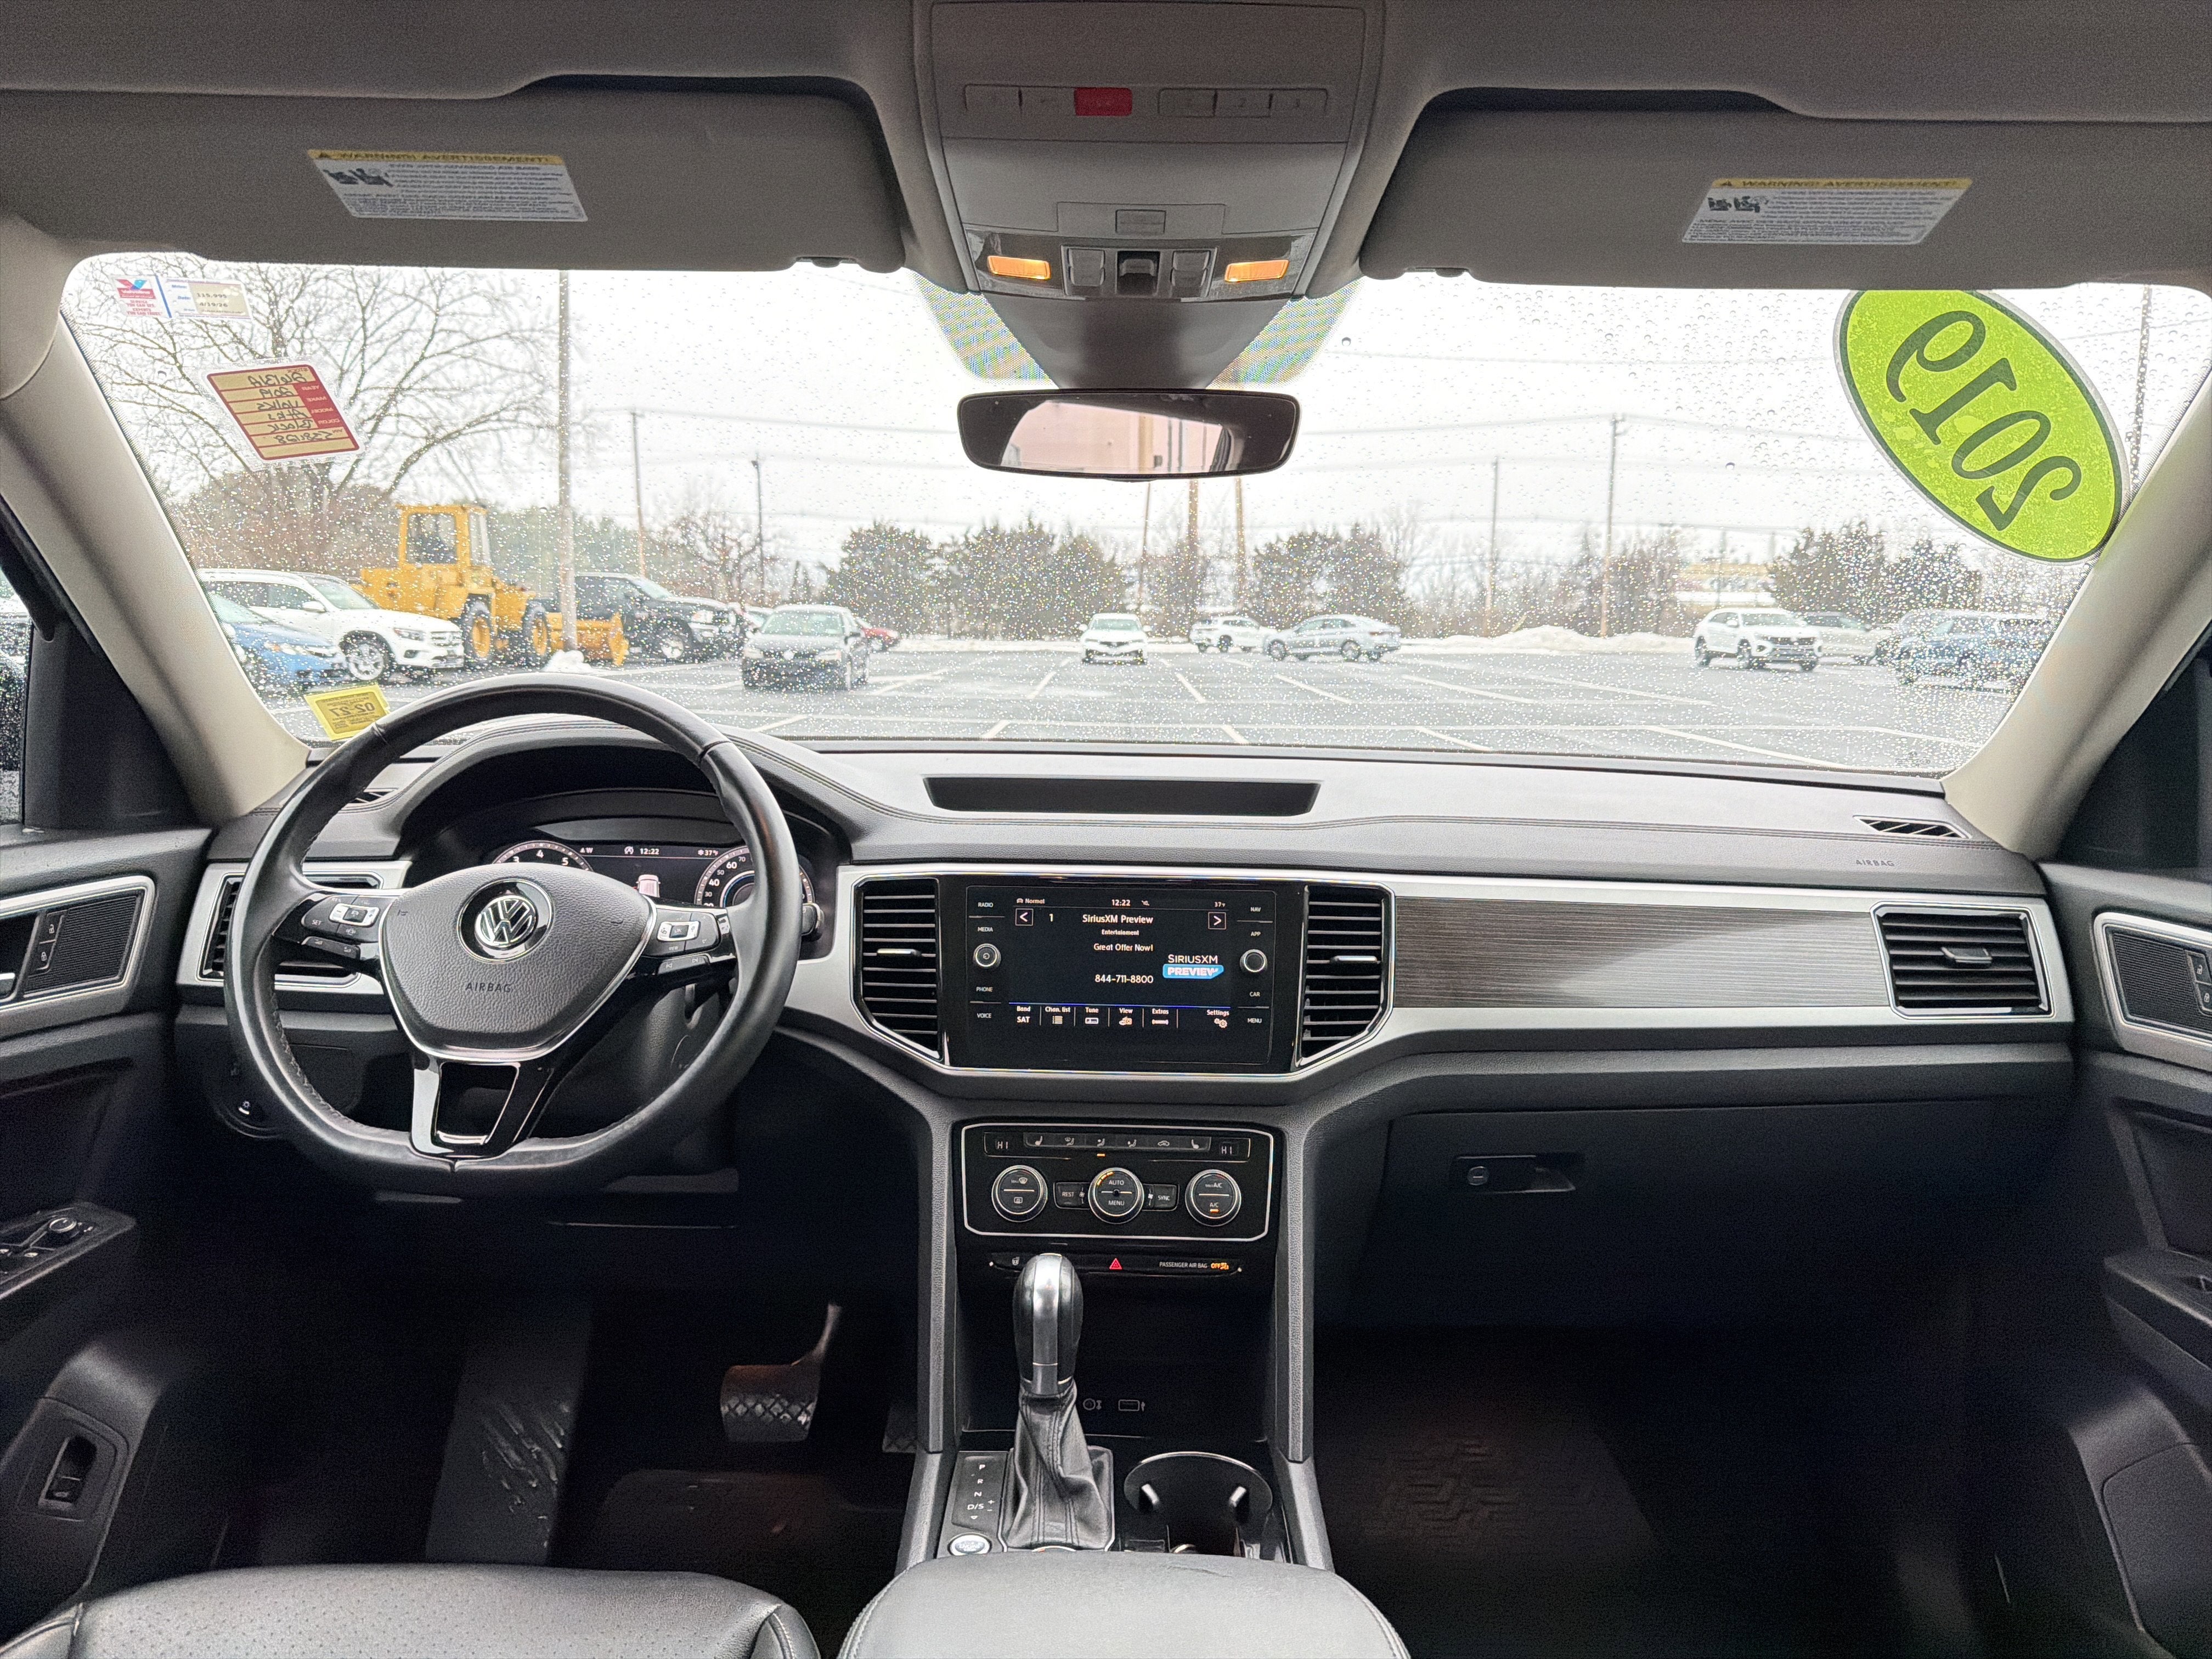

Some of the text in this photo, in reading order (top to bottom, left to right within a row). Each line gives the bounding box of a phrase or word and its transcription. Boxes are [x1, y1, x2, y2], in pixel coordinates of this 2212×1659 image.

[535, 849, 544, 859] 4
[561, 857, 569, 866] 5
[726, 861, 738, 870] 60
[1855, 859, 1895, 867] AIRBAG
[708, 878, 720, 887] 40
[1049, 913, 1054, 922] 1
[1082, 914, 1154, 924] SiriusXM Preview
[1093, 943, 1113, 951] Great
[1135, 944, 1154, 952] Now!
[1167, 953, 1218, 964] SIRIUSXM
[1167, 967, 1219, 976] PREVIEW
[1094, 974, 1154, 984] 844-711-8800
[465, 981, 512, 995] AIRBAG
